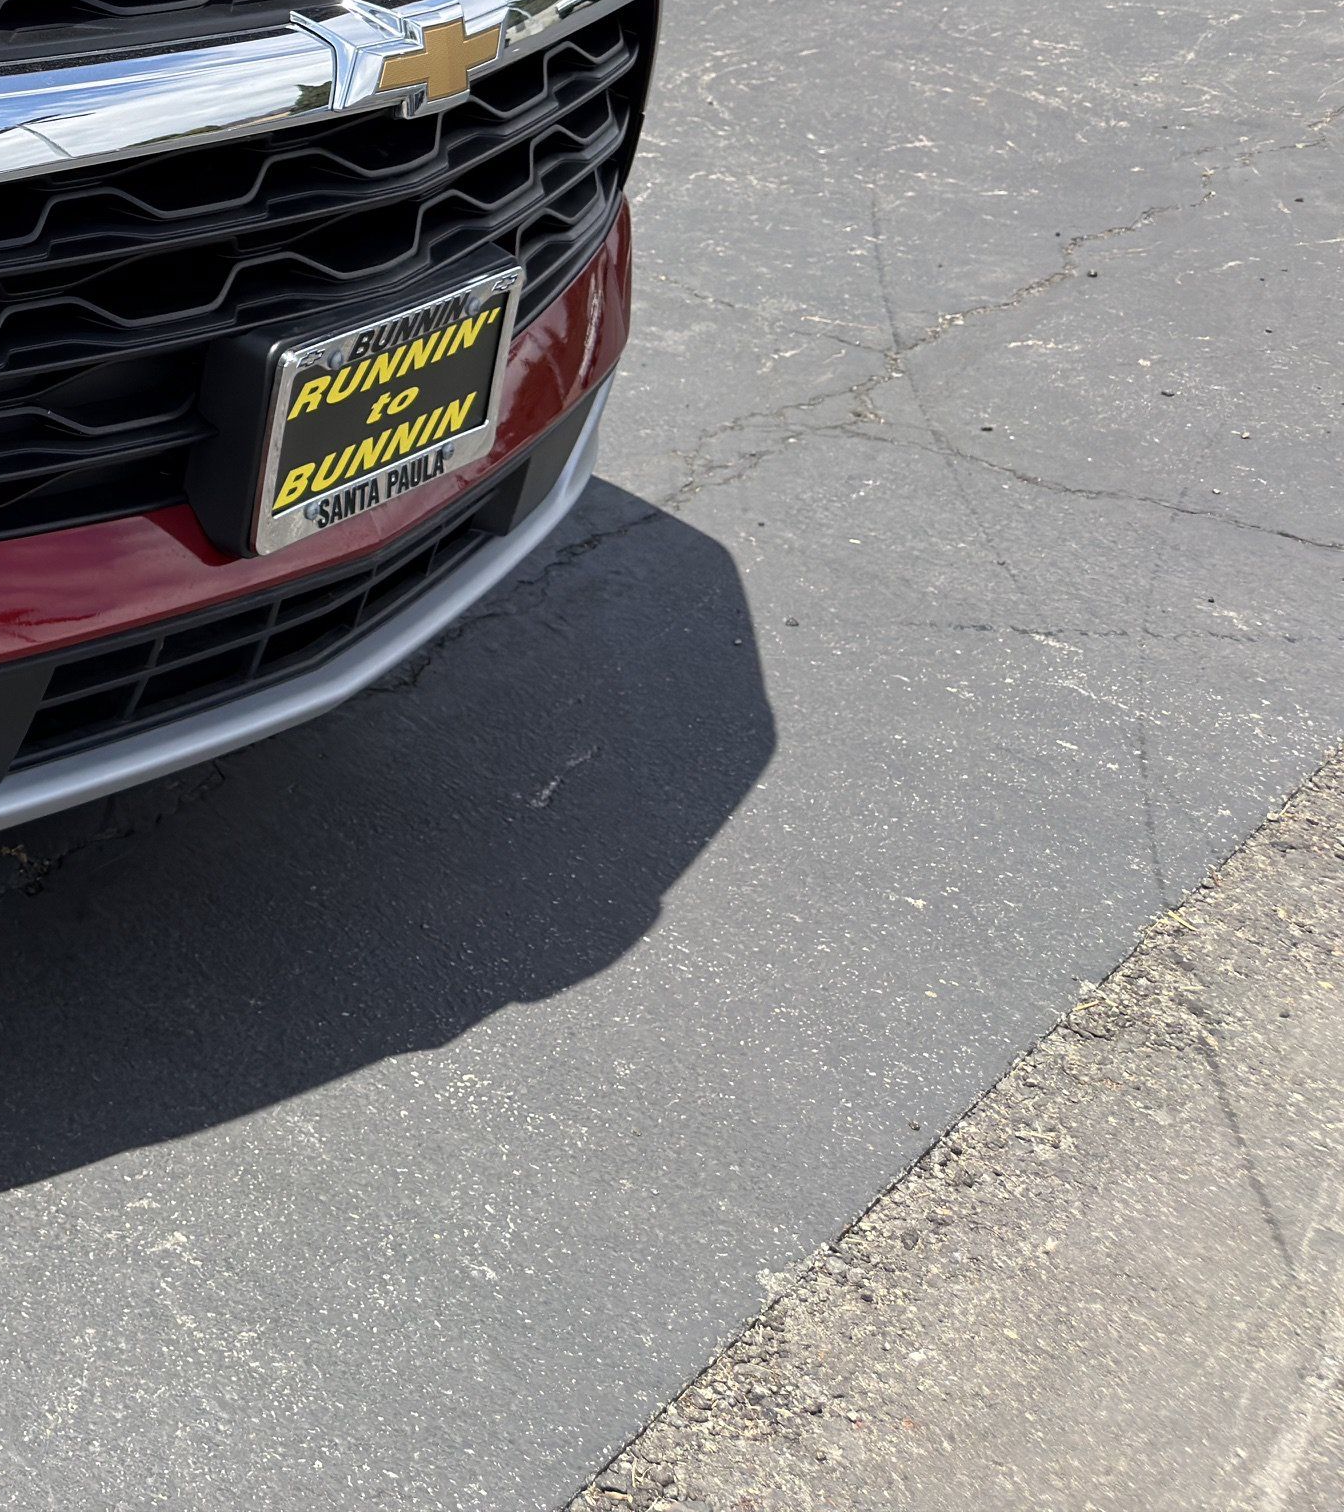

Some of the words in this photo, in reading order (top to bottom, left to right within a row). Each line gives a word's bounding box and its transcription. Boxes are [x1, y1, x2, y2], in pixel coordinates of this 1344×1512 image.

[287, 307, 501, 421] RUNNIN'
[347, 289, 473, 363] BUNNIN
[366, 386, 419, 424] to
[272, 391, 477, 510] BUNNIN
[317, 478, 379, 528] SANTA
[386, 449, 444, 498] PAULA
